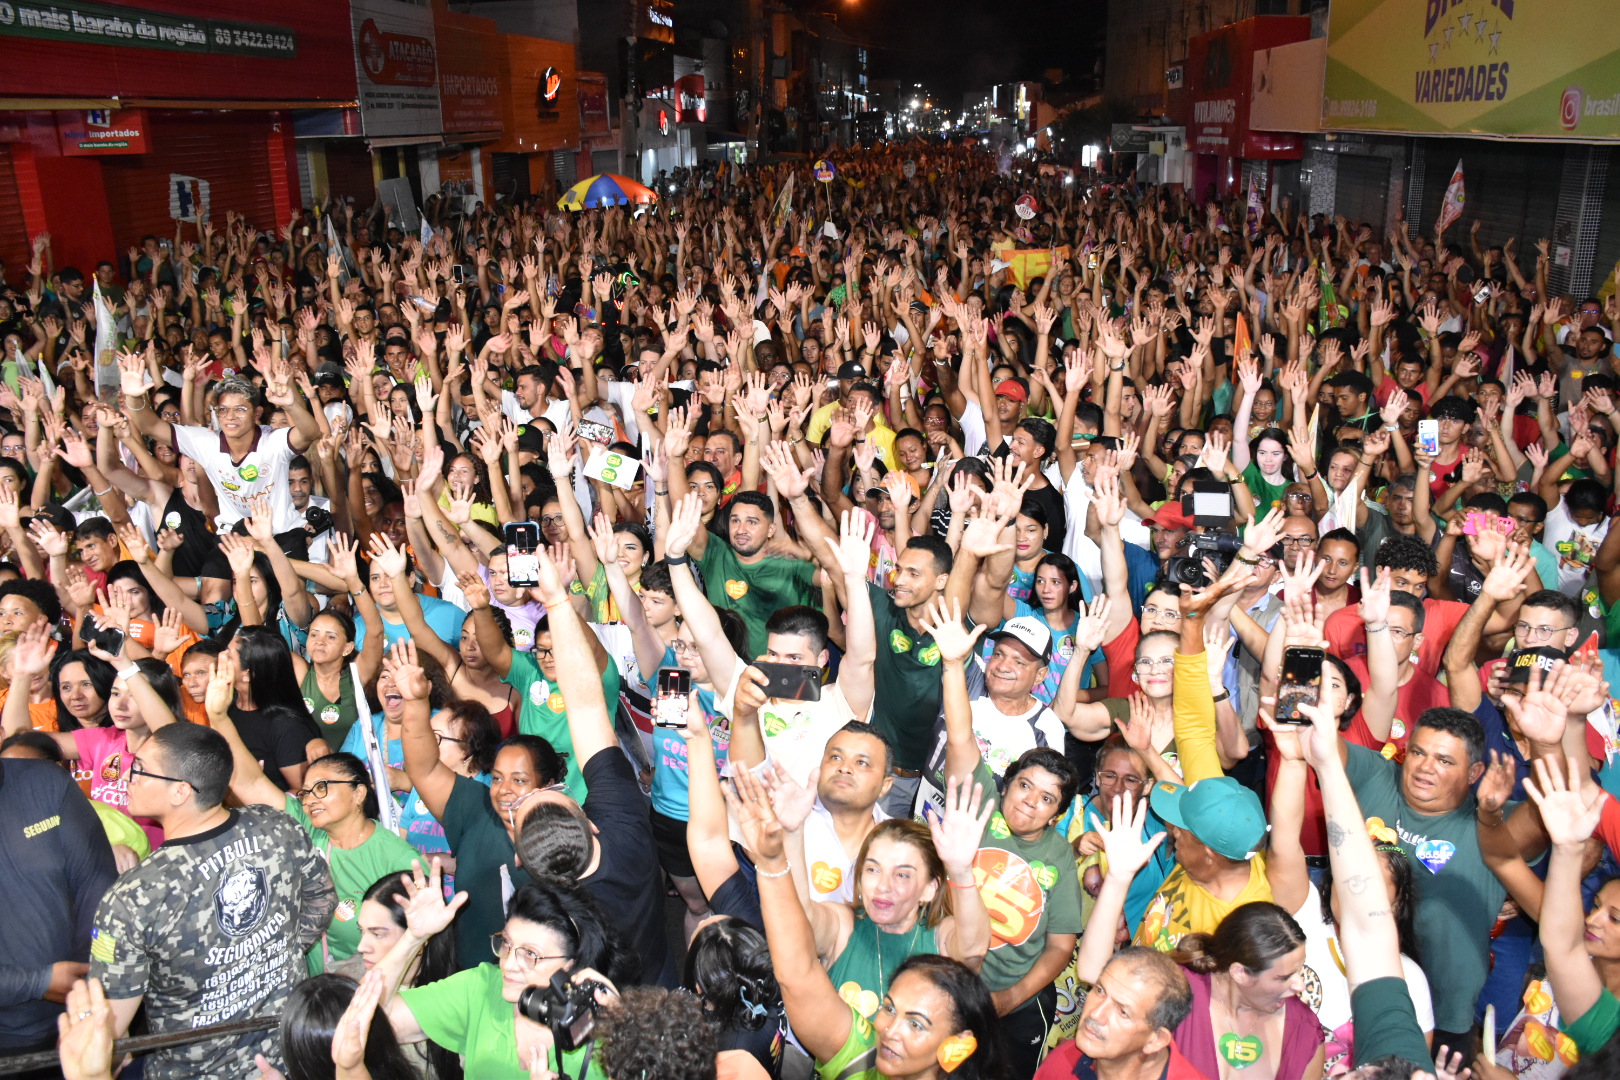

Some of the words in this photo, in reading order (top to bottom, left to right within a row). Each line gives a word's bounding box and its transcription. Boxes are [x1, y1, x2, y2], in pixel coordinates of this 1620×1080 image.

[18, 7, 70, 32] mais
[71, 10, 133, 39] barato
[135, 18, 157, 41] da
[158, 23, 206, 46] região
[214, 27, 232, 46] 89
[233, 29, 294, 51] 3422.9424
[388, 38, 433, 65] ATACADÃO
[442, 74, 499, 97] IMPORTADOS
[1415, 61, 1510, 104] VARIEDADES
[88, 128, 140, 139] Importados
[1008, 250, 1064, 292] 15
[241, 467, 258, 480] 15
[1557, 542, 1573, 552] 15
[728, 583, 745, 595] 15
[892, 634, 911, 652] 15
[922, 646, 941, 662] 15
[764, 717, 787, 733] 15
[990, 817, 1011, 836] 15
[198, 835, 262, 881] PITBULL
[813, 867, 840, 889] 15
[1033, 866, 1056, 887] 15
[230, 969, 254, 992] COM
[192, 1013, 220, 1028] FALA
[221, 1000, 248, 1022] COM
[943, 1043, 972, 1064] 15
[1225, 1039, 1257, 1062] 15
[1528, 1029, 1552, 1061] 15
